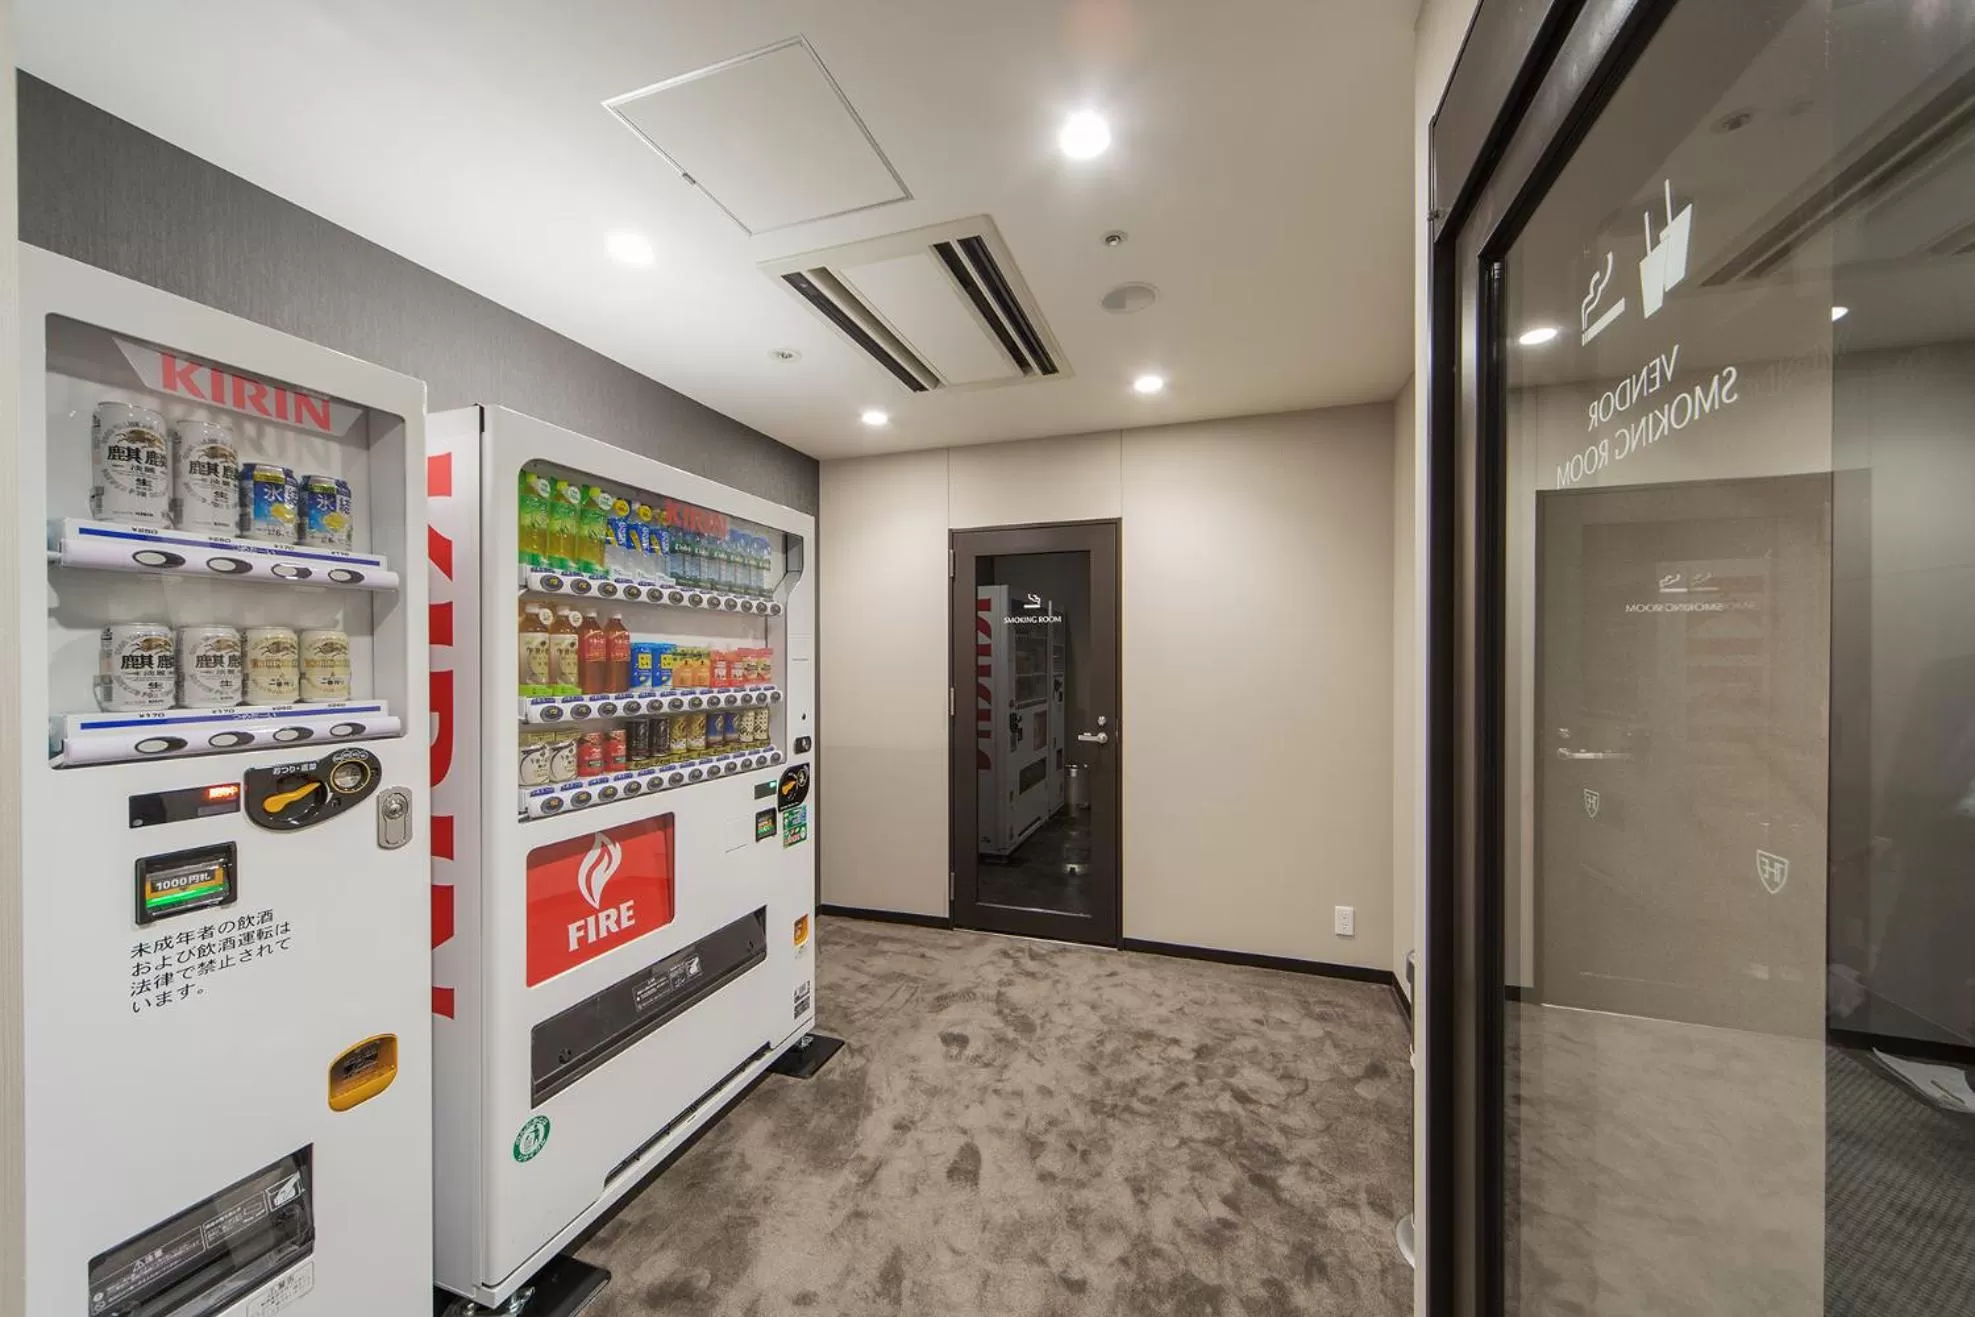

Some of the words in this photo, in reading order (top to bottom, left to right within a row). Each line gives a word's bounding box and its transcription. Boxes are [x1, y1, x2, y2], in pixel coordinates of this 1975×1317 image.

[162, 352, 333, 433] KIRIN
[664, 498, 729, 543] KIRIN
[1003, 615, 1037, 624] SMOKING
[1038, 615, 1062, 624] ROOM
[131, 909, 274, 959] 未成年者の飲酒
[131, 921, 292, 977] および飲酒運転は
[568, 900, 636, 953] FIRE
[130, 937, 292, 997] 法律で禁止されて
[131, 983, 205, 1014] います。
